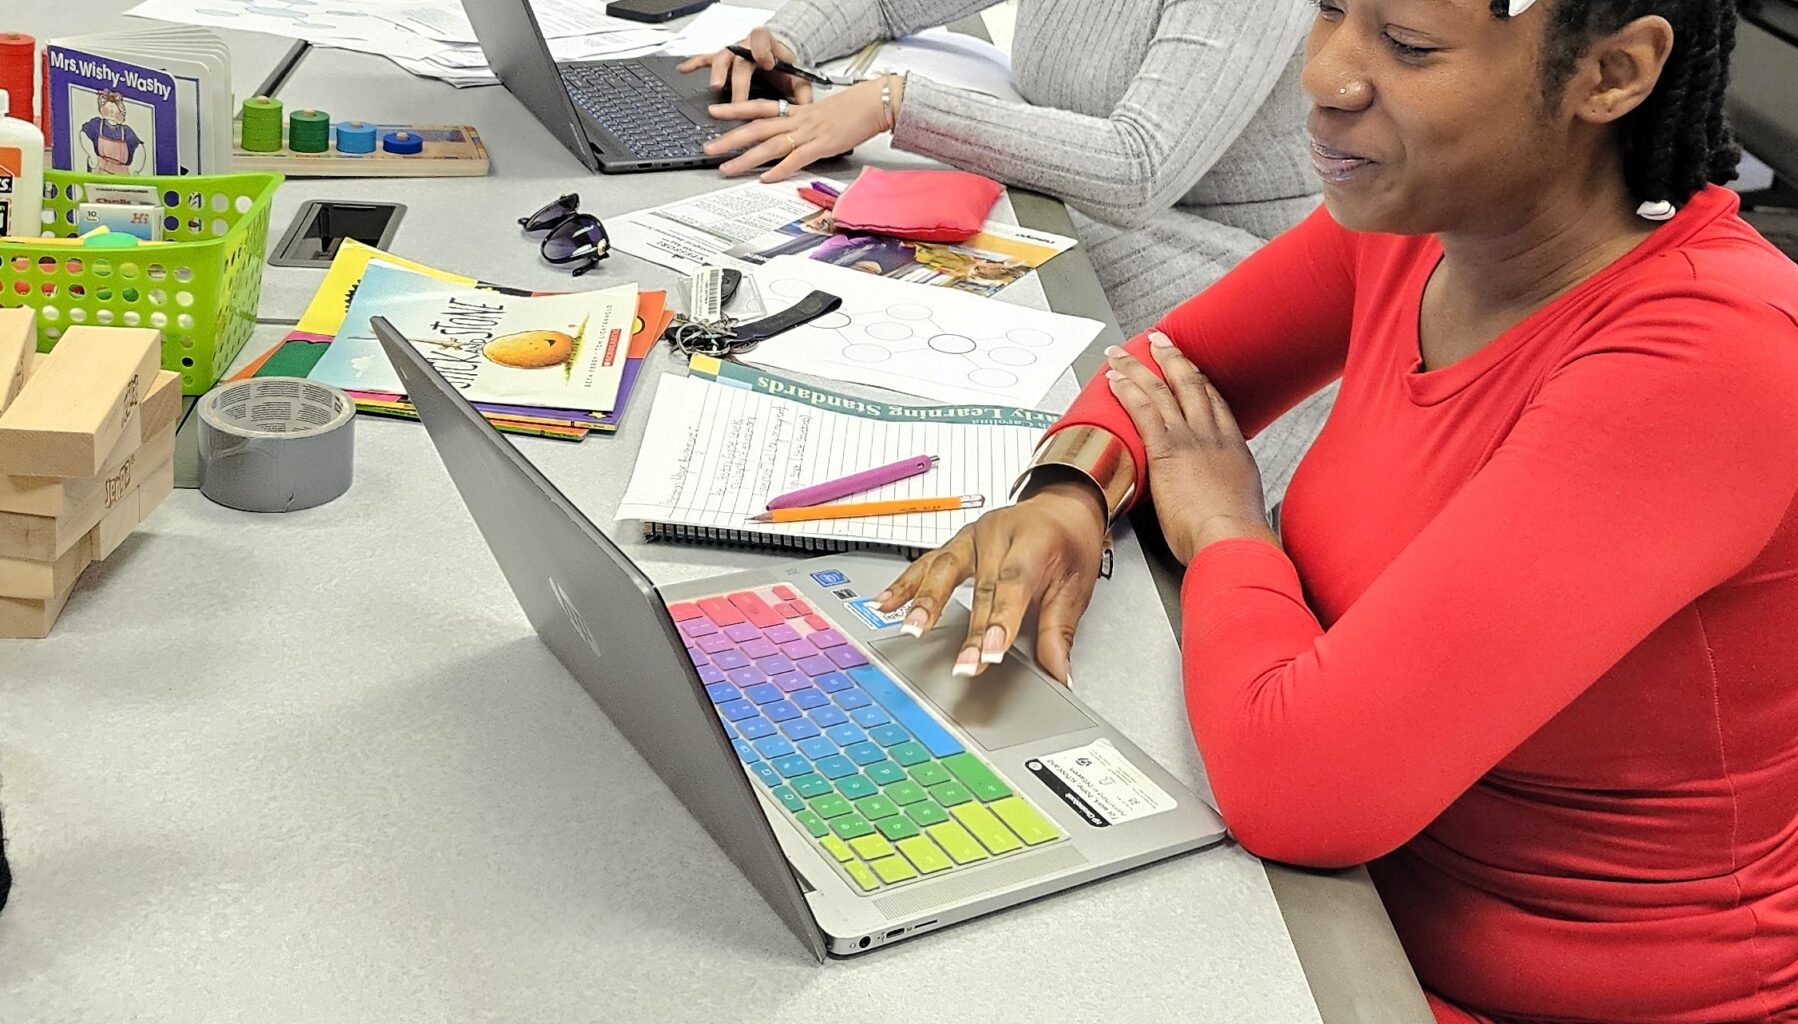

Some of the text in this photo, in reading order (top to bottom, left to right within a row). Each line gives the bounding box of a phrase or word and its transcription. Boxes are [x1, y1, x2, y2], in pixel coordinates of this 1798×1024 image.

[79, 60, 171, 101] Wishy-Washy
[430, 297, 507, 338] STONE
[757, 377, 1059, 422] arly Learning Standards
